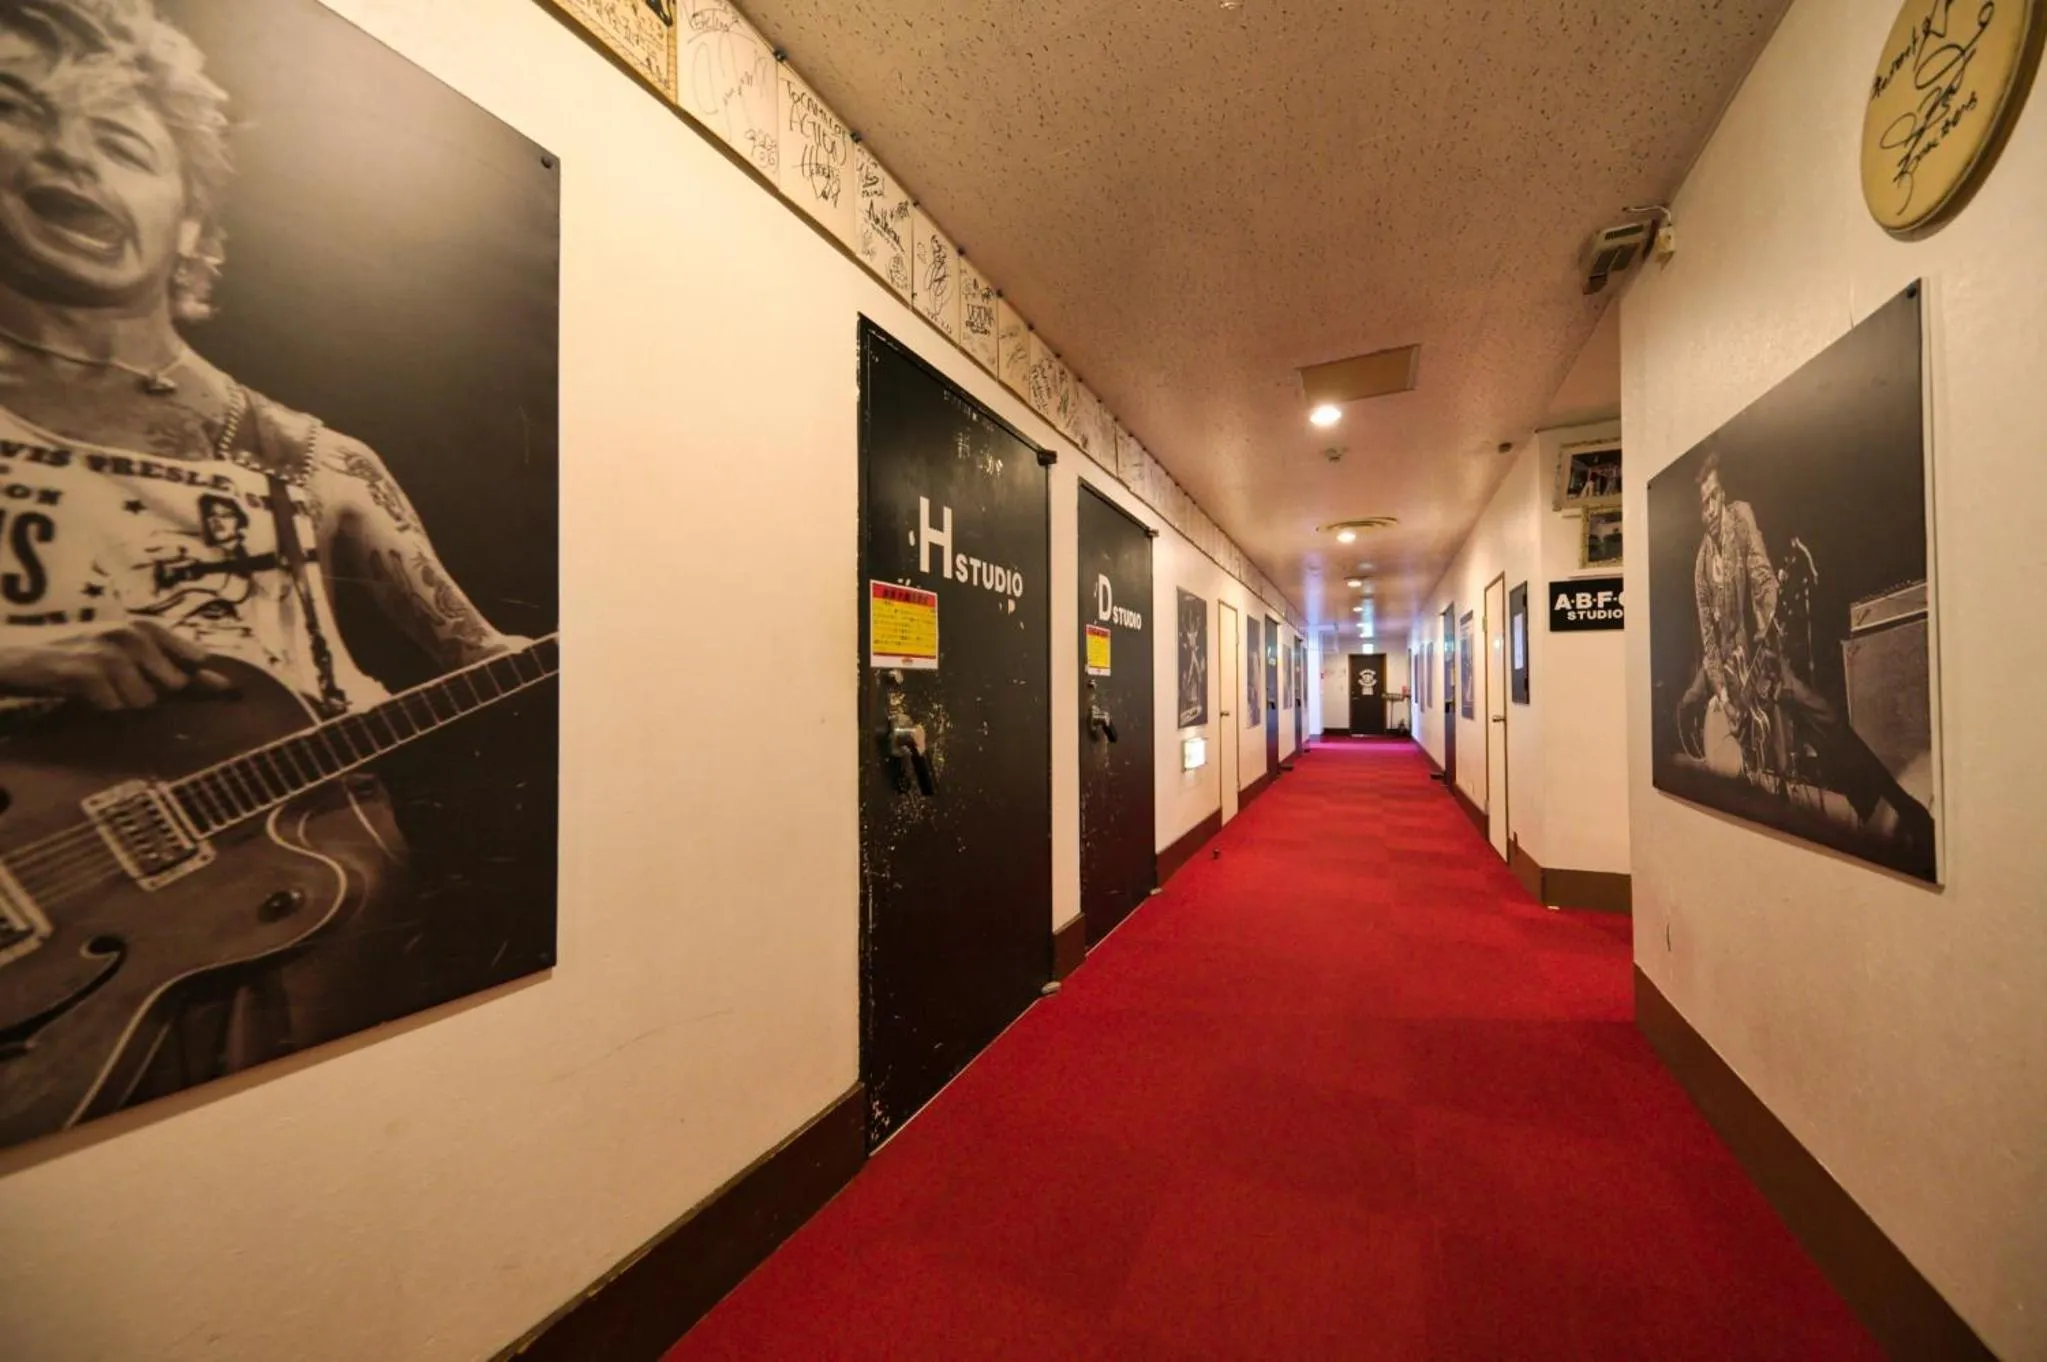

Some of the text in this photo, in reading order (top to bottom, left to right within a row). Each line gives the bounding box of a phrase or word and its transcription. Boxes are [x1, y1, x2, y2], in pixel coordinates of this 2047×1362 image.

[919, 496, 1024, 598] H STUDIO
[1098, 574, 1142, 631] D STUDIO
[1567, 609, 1624, 621] STUDIO
